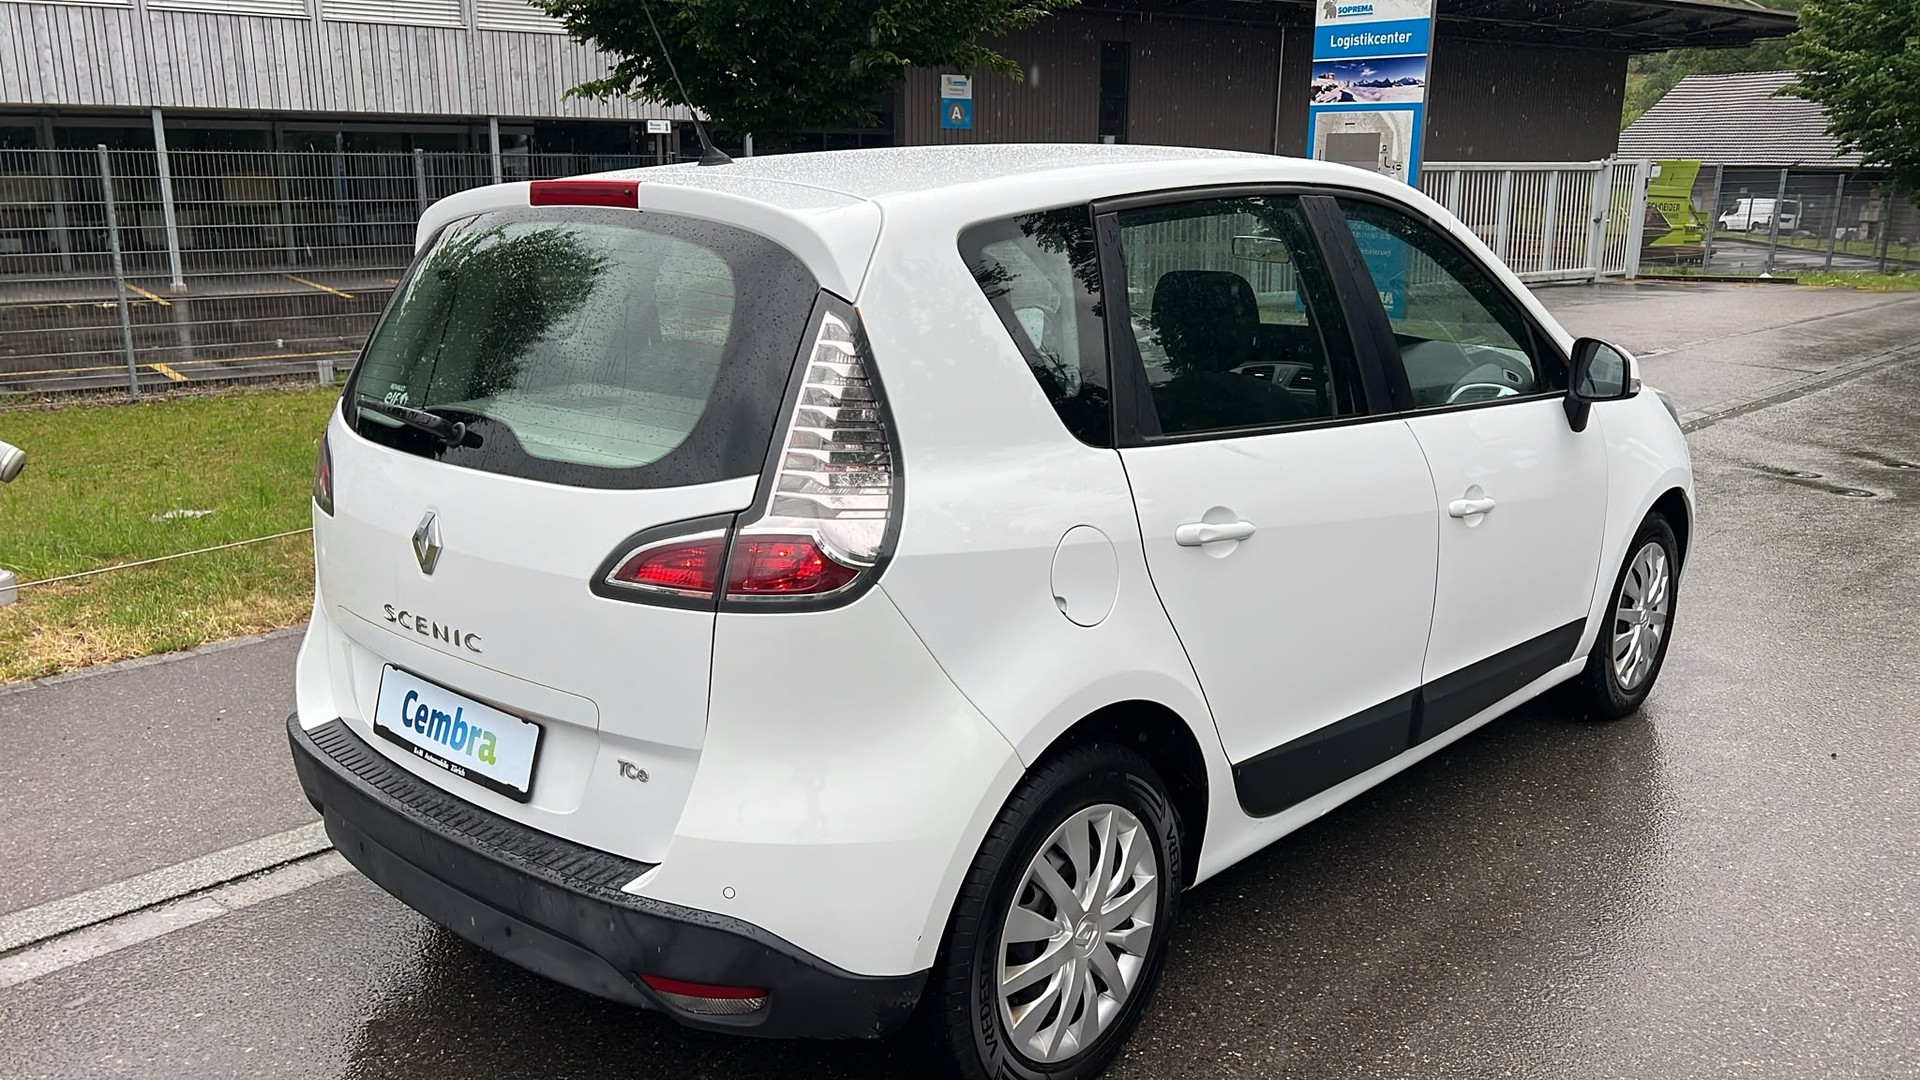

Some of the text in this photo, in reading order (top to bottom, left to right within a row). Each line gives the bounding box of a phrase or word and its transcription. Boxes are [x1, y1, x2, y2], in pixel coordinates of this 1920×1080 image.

[1338, 5, 1373, 14] SOPREMA
[1330, 31, 1413, 50] Logistikcenter
[951, 106, 962, 120] A
[383, 603, 483, 653] SCENIC
[401, 690, 497, 766] Cembra
[617, 758, 650, 782] TCe
